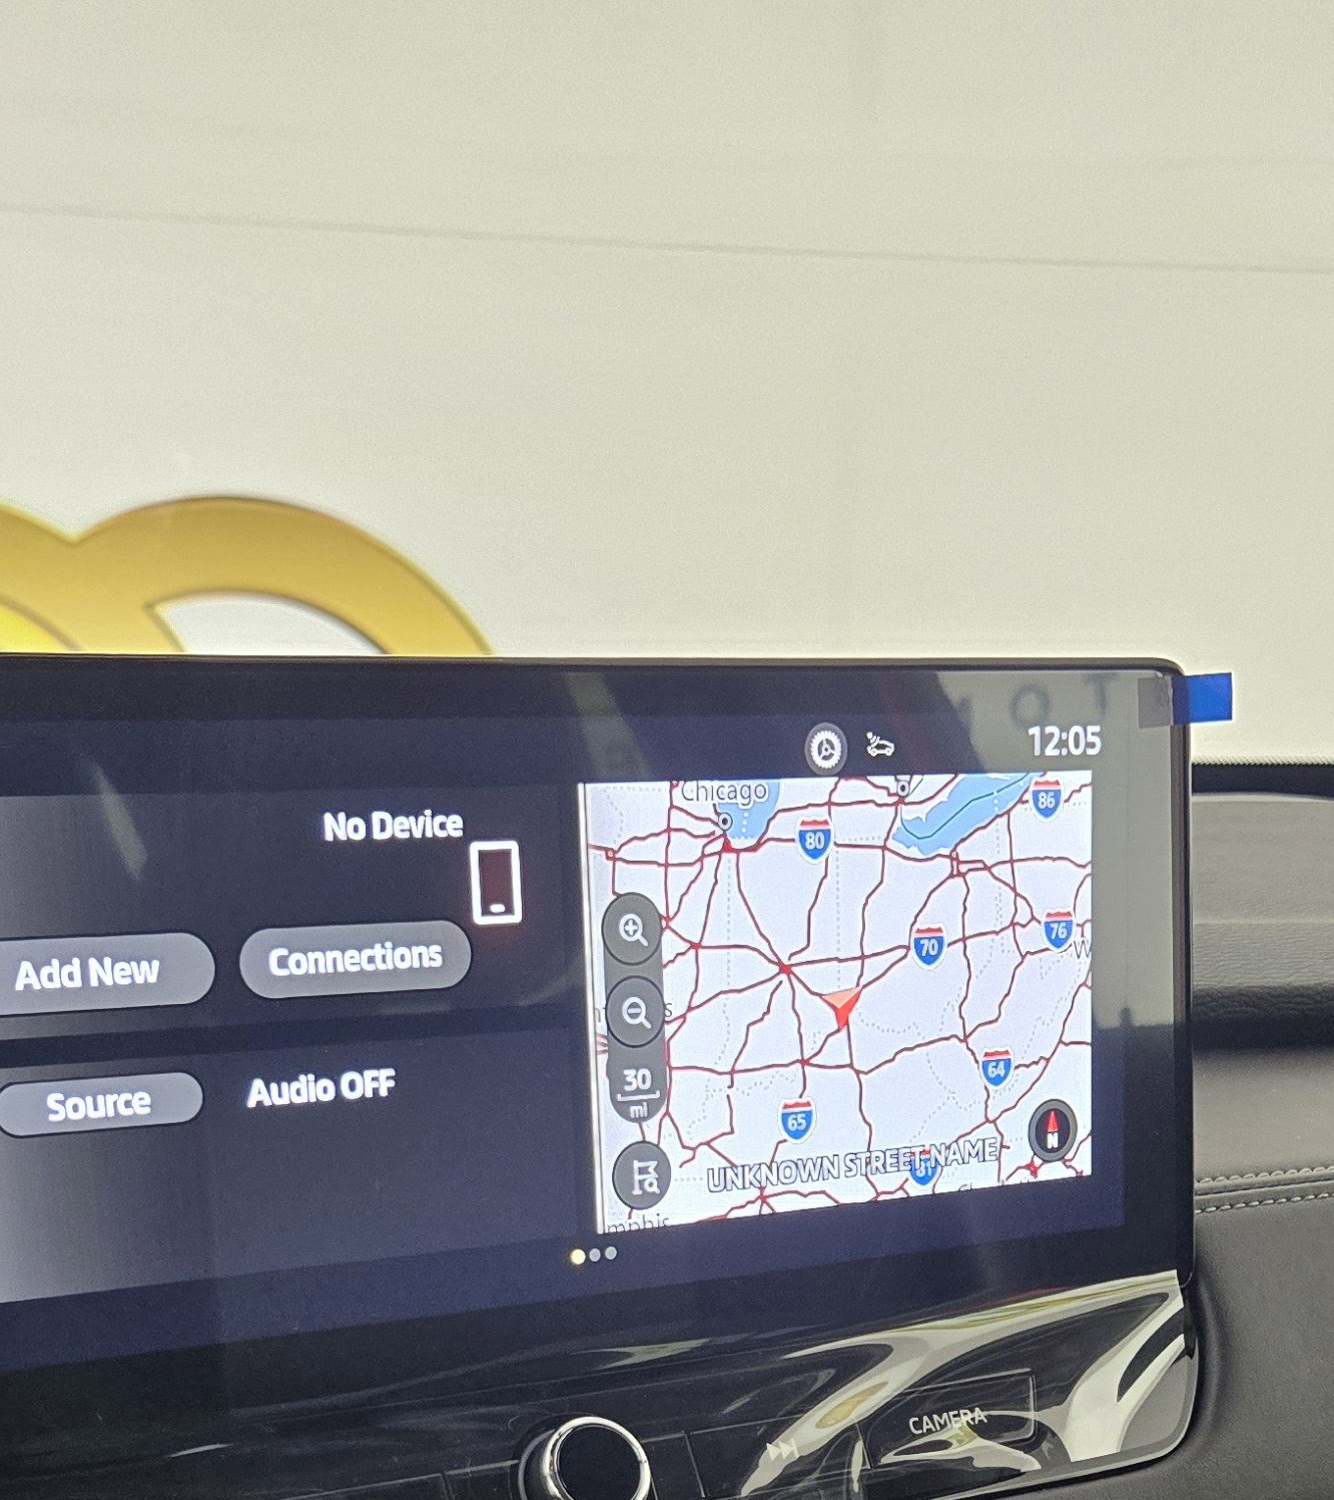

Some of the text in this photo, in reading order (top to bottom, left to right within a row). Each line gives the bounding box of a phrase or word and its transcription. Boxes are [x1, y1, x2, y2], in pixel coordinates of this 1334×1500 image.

[1028, 725, 1101, 756] 12:05
[681, 781, 768, 806] Chicago
[1038, 792, 1055, 809] 86
[323, 809, 463, 841] No Device
[804, 832, 825, 850] 80
[1050, 922, 1067, 939] 76
[268, 942, 443, 977] Connections
[920, 939, 938, 957] 70
[14, 956, 160, 991] Add New
[623, 1068, 652, 1091] 30
[987, 1061, 1005, 1080] 64
[246, 1068, 396, 1107] Audio OFF
[47, 1090, 151, 1122] Source
[788, 1112, 806, 1131] 65
[707, 1137, 998, 1193] UNKNOWN STREET NAME
[908, 1407, 988, 1435] CAMERA
